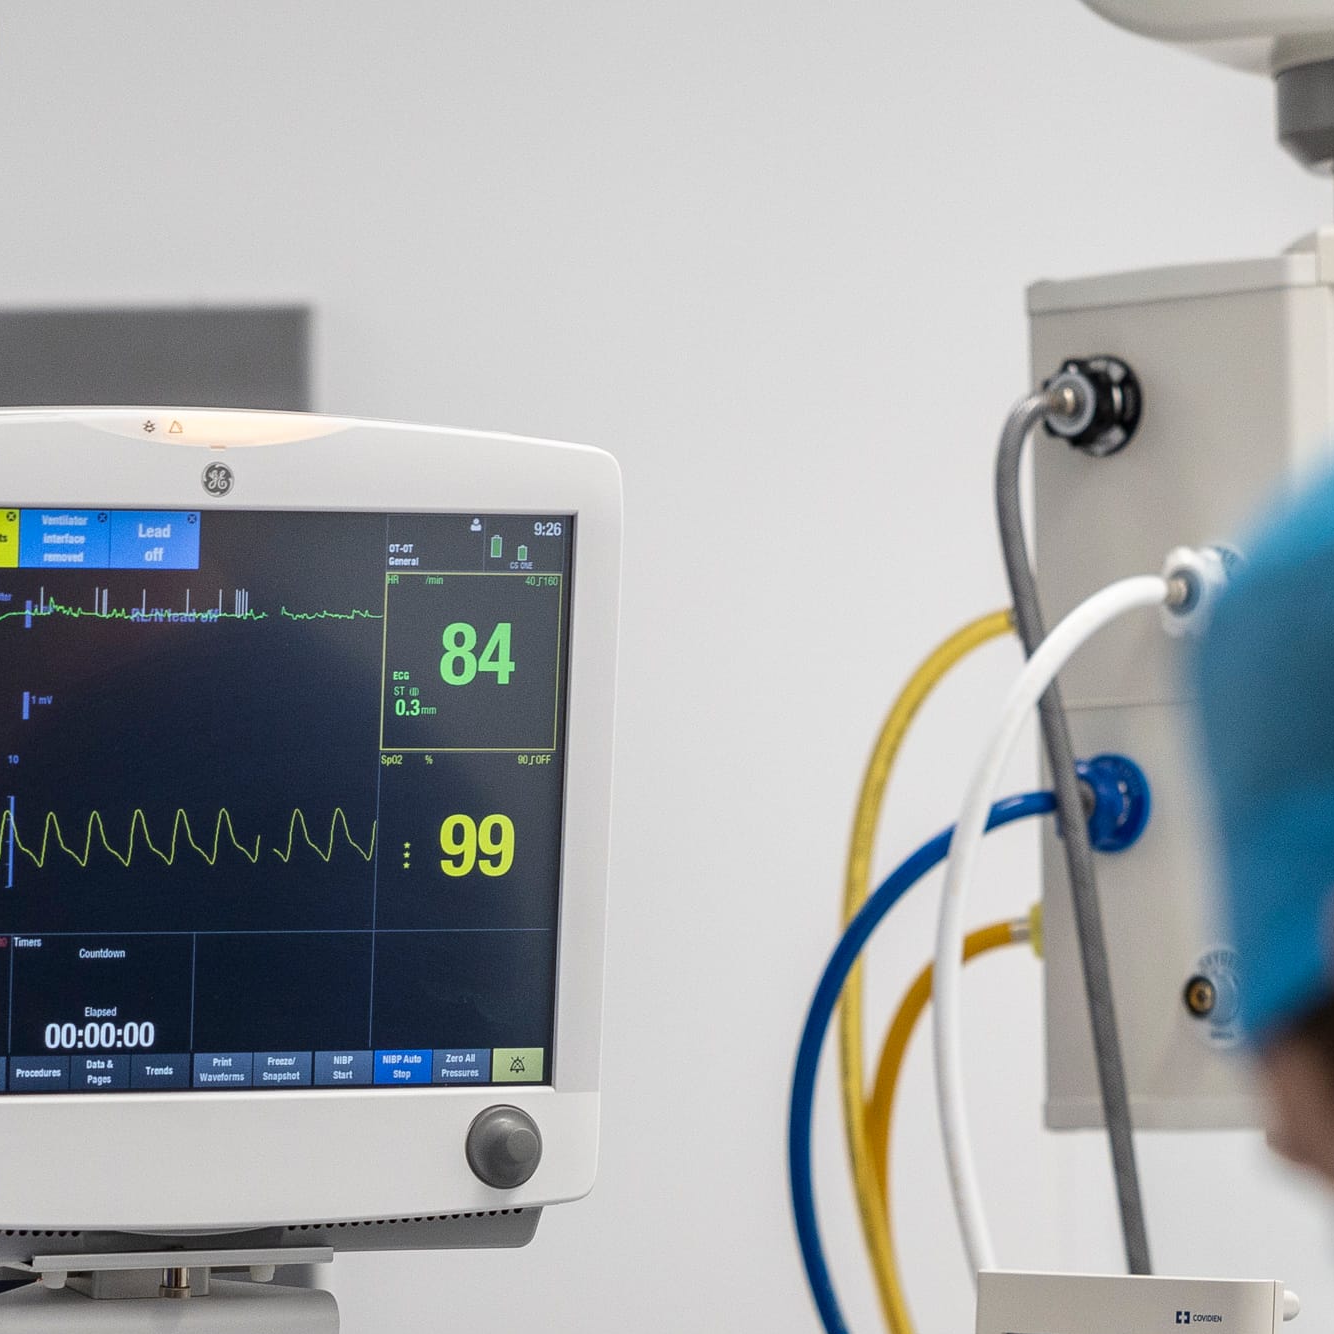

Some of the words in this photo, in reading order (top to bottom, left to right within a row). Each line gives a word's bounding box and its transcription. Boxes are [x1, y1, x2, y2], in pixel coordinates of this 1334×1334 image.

[42, 515, 87, 525] Ventilator
[139, 524, 171, 538] Lead
[534, 523, 562, 536] 9:26
[44, 534, 86, 544] interface
[44, 552, 83, 562] removed
[145, 548, 163, 561] off
[389, 557, 419, 566] General
[387, 575, 399, 584] HR
[426, 576, 444, 585] /min
[440, 622, 515, 686] 84
[393, 672, 409, 680] ECG
[394, 687, 405, 695] ST
[395, 699, 420, 716] 0.3
[440, 814, 515, 877] 99
[14, 937, 42, 947] Timers
[79, 949, 125, 958] Countdown
[85, 1007, 117, 1017] Elapsed
[45, 1022, 155, 1048] 00:00:00
[213, 1058, 232, 1066] Print
[268, 1057, 296, 1066] Freeze/
[333, 1056, 353, 1065] NIBP
[382, 1055, 402, 1064] NIBP
[404, 1054, 421, 1063] Auto
[446, 1053, 458, 1063] Zero
[461, 1053, 475, 1063] All
[86, 1060, 104, 1069] Data
[16, 1068, 61, 1078] Procedures
[146, 1067, 173, 1075] Trends
[333, 1069, 353, 1079] Start
[393, 1069, 411, 1080] Stop
[441, 1068, 479, 1078] Pressures
[87, 1075, 111, 1086] Pages
[200, 1073, 244, 1081] Waveforms
[263, 1071, 299, 1082] Snapshot
[1193, 1314, 1222, 1322] COVIDIEN
